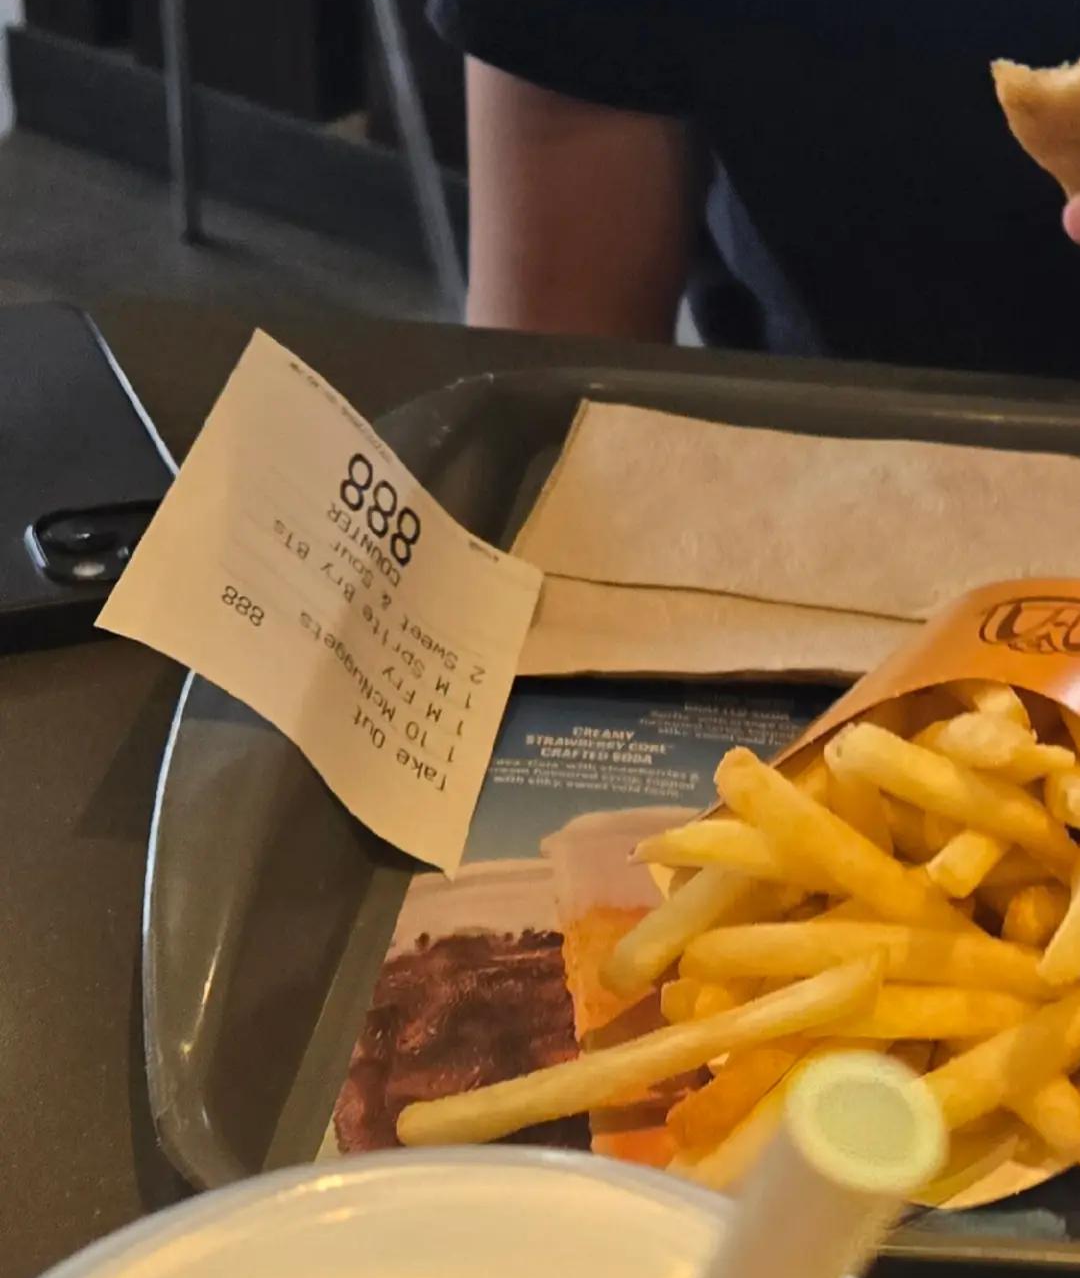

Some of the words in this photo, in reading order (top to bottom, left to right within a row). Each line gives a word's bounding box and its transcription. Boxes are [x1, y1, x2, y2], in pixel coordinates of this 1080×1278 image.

[340, 452, 421, 567] 888
[327, 502, 401, 588] COUNTER
[331, 541, 374, 589] Sour
[320, 562, 355, 602] Bry
[221, 585, 265, 627] 888
[400, 614, 458, 671] Sweet
[300, 612, 396, 722] McNuggets
[382, 666, 415, 705] Fry
[435, 675, 450, 697] M
[469, 665, 486, 685] 2
[353, 705, 386, 749] Out
[426, 703, 442, 722] M
[572, 725, 635, 740] CREAMY
[405, 721, 427, 747] 10
[526, 734, 624, 751] STRAWBERRY
[396, 748, 447, 792] Take
[540, 748, 609, 761] CRAFTED
